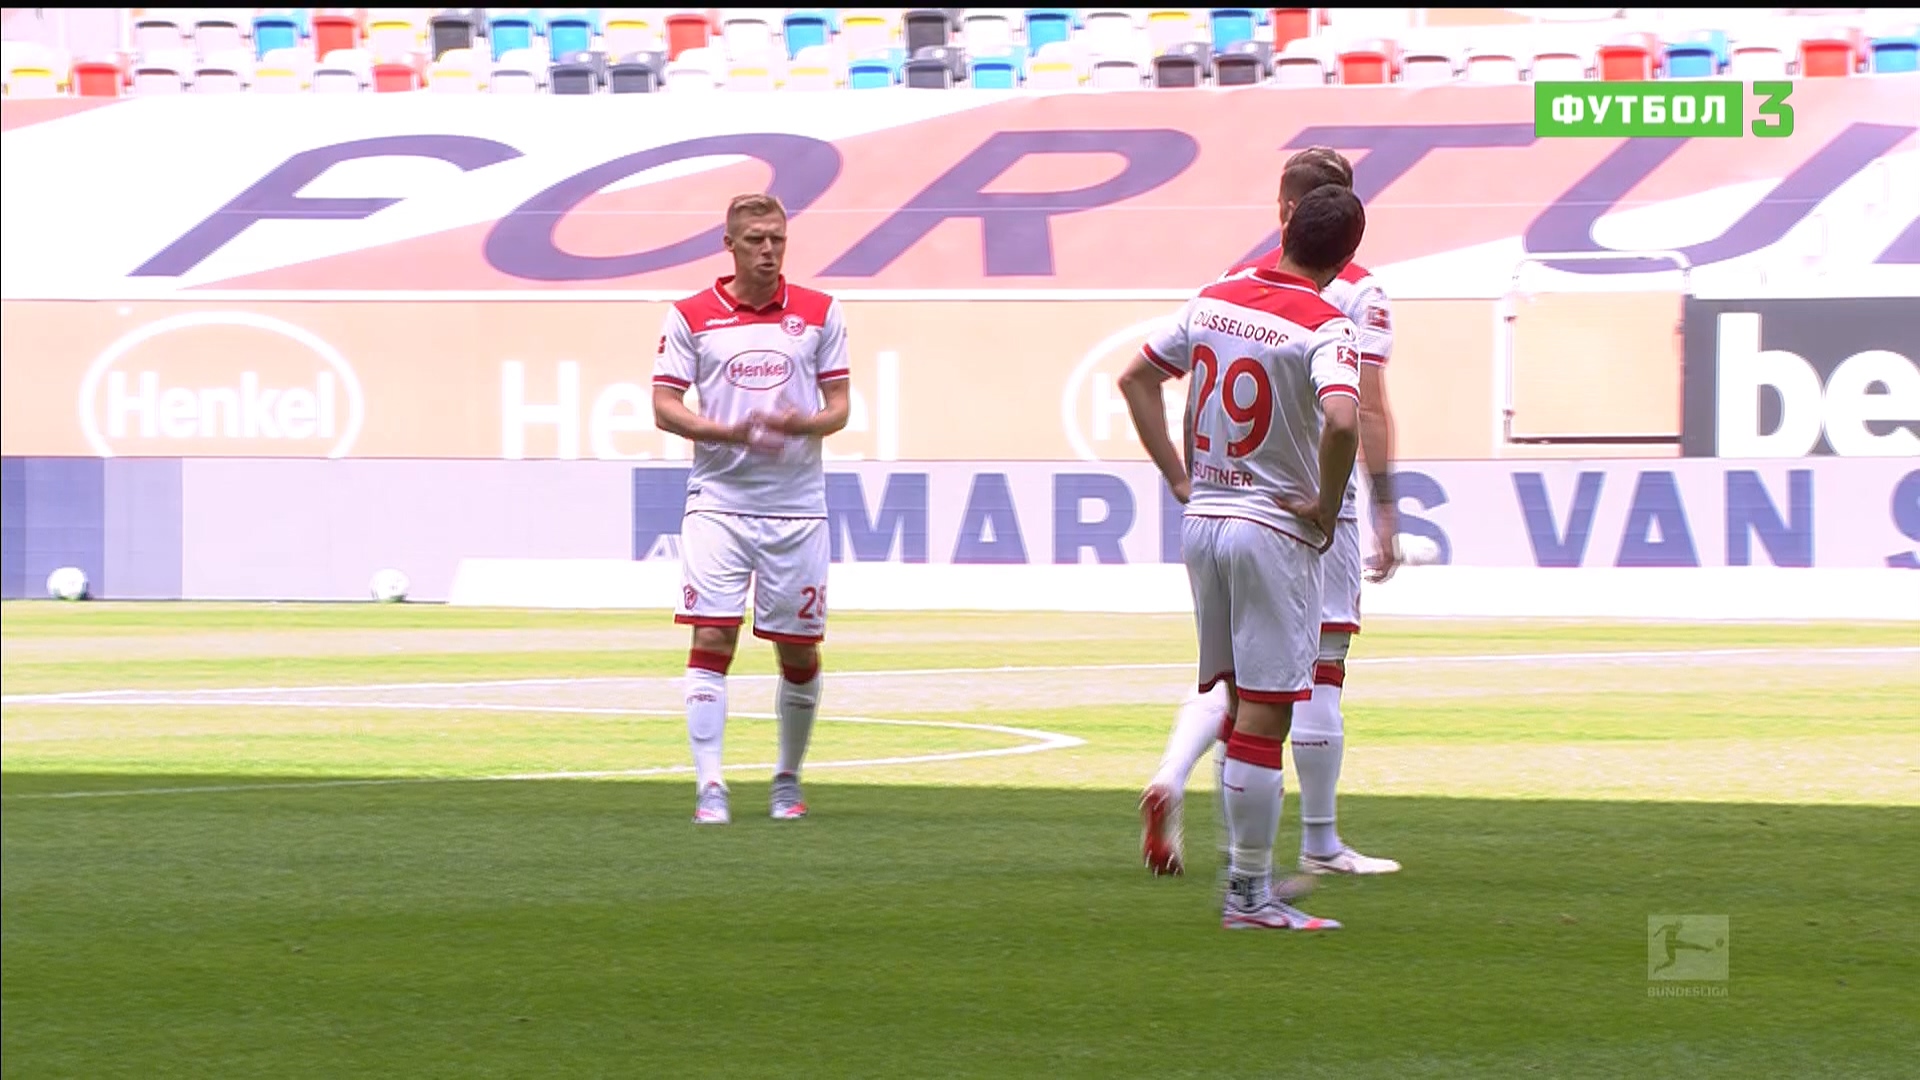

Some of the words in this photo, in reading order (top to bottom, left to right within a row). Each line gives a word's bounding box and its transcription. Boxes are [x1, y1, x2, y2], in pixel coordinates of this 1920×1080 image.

[126, 132, 1920, 282] FORTU
[1193, 309, 1289, 347] DÜSSELDORF
[730, 361, 789, 378] Henkel
[1191, 343, 1273, 459] 29
[107, 370, 336, 439] Henkel
[1193, 460, 1254, 487] SUTTNER
[1512, 469, 1815, 567] VAN
